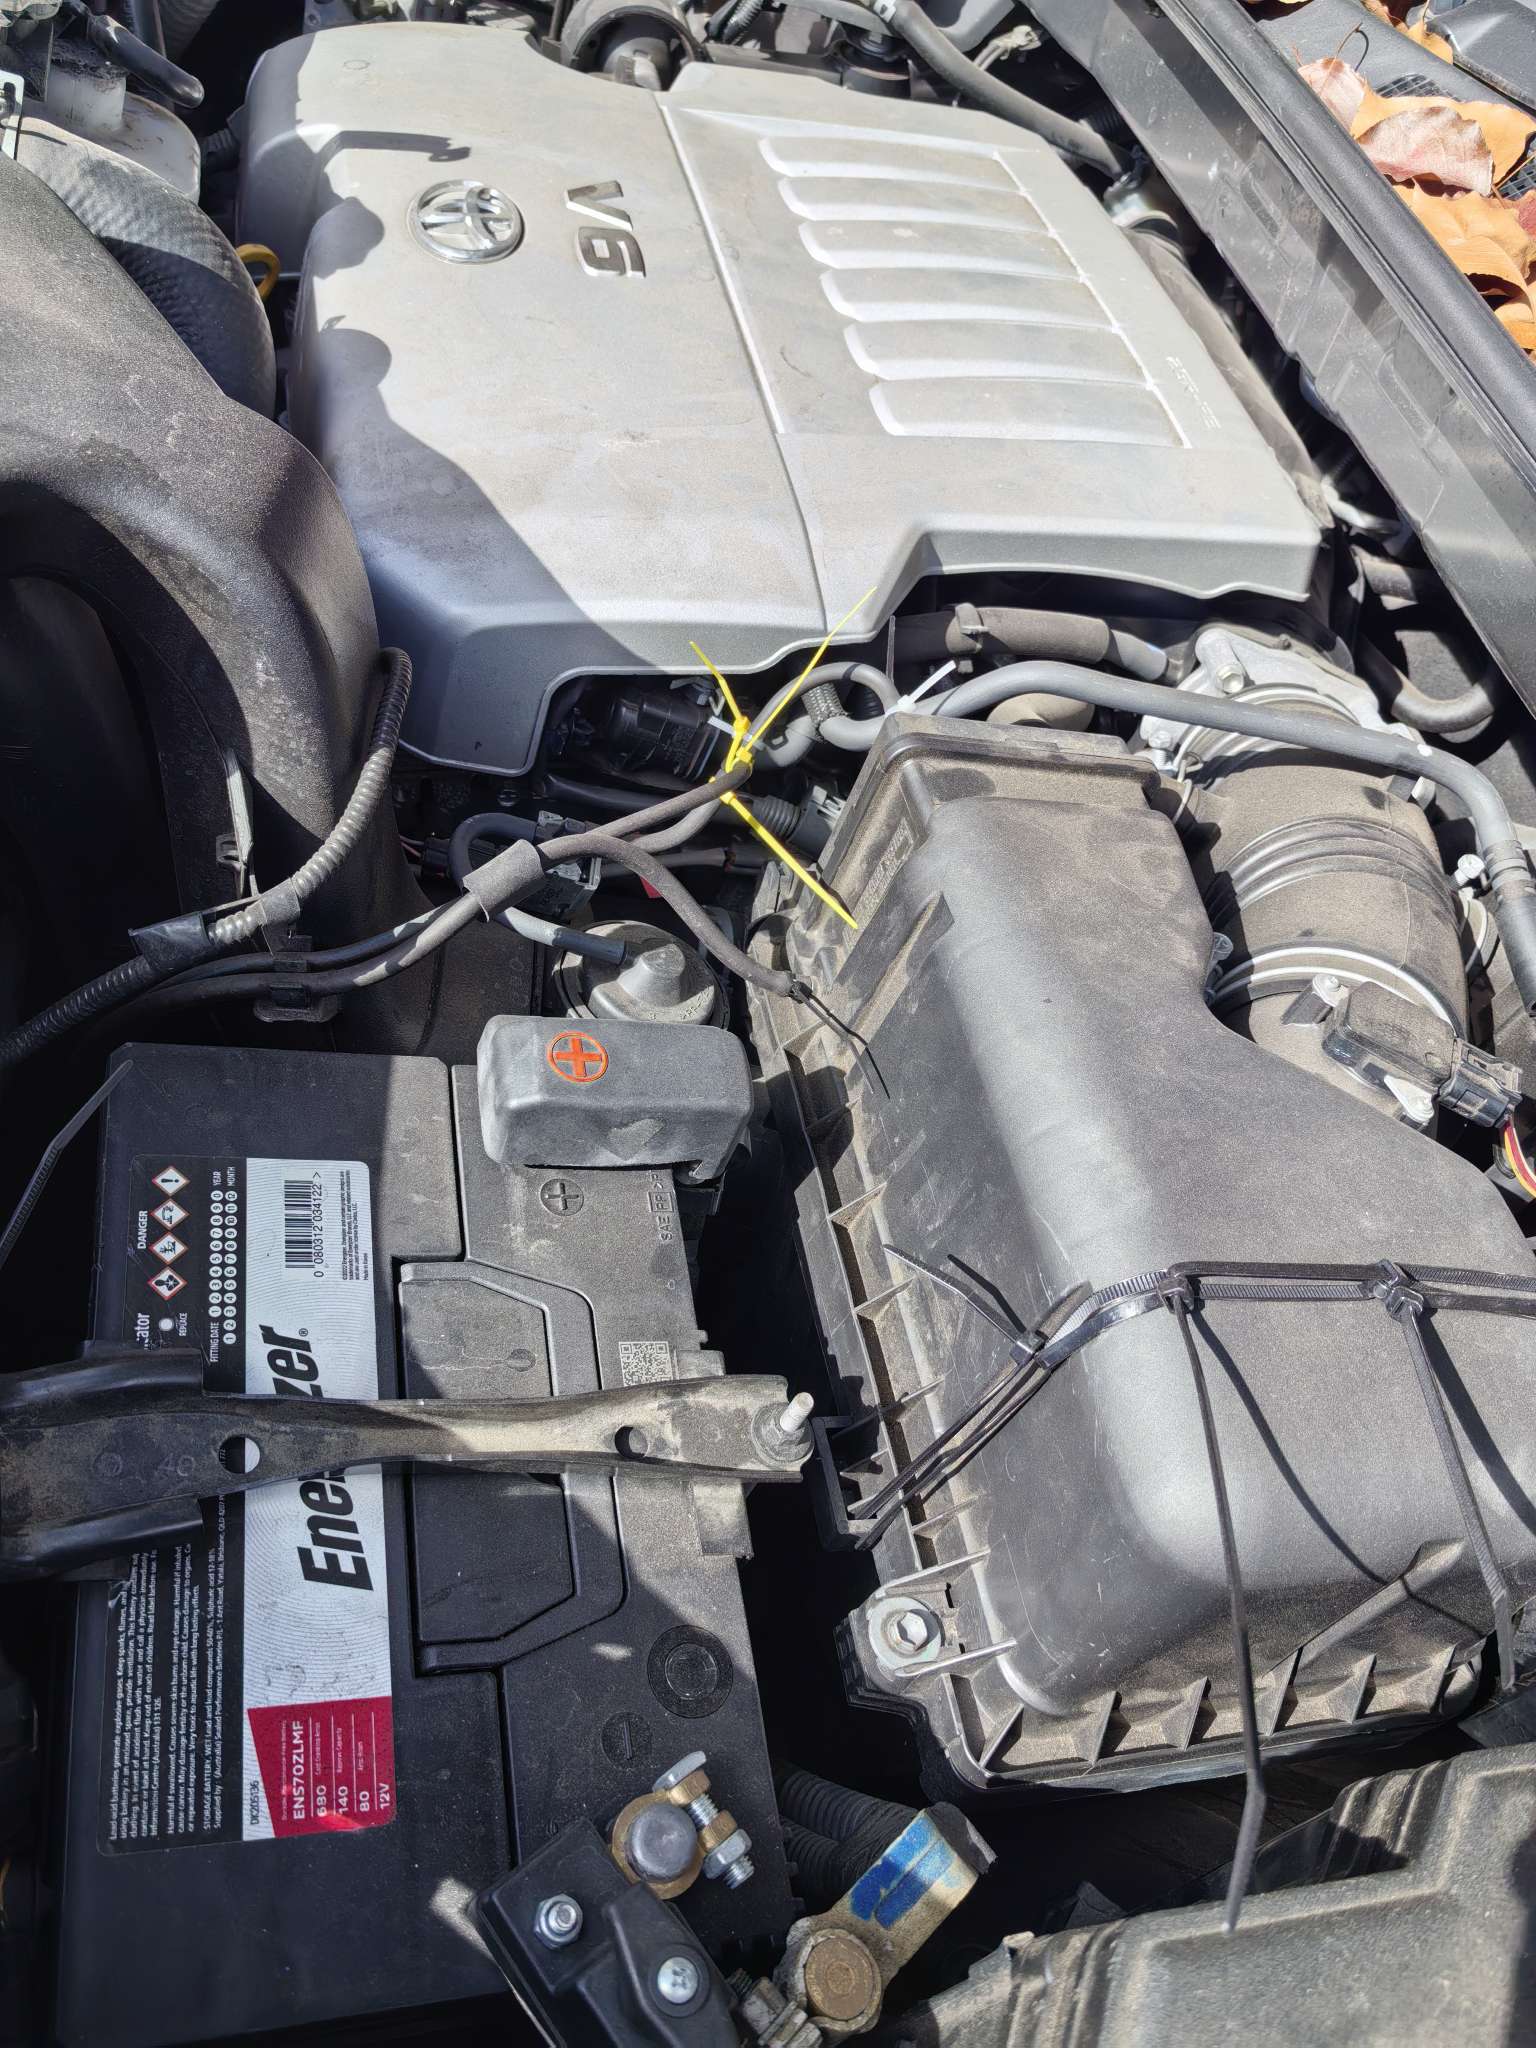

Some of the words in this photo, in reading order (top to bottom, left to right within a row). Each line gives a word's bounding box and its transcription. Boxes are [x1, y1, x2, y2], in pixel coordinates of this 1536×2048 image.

[565, 179, 645, 278] V6
[213, 1171, 222, 1186] YEAR
[227, 1166, 236, 1186] MONTH
[312, 1184, 322, 1222] 034122
[654, 1194, 668, 1210] PP
[137, 1210, 148, 1250] DANGER
[656, 1216, 672, 1241] SAE
[313, 1225, 324, 1264] 080312
[179, 1312, 188, 1337] REPLACE
[210, 1322, 219, 1338] DATE
[210, 1339, 219, 1362] FITTING
[129, 1597, 138, 1621] battery
[139, 1596, 148, 1626] physician
[184, 1587, 192, 1615] damage
[192, 1609, 200, 1631] lasting
[117, 1658, 126, 1675] Keep
[137, 1649, 145, 1662] and
[147, 1664, 154, 1672] of
[207, 1648, 215, 1688] compounds
[125, 1679, 134, 1706] provide
[183, 1699, 188, 1707] or
[191, 1678, 199, 1704] aquatic
[114, 1700, 124, 1734] explosive
[135, 1707, 143, 1725] flush
[145, 1704, 153, 1717] out
[181, 1709, 189, 1734] fertility
[191, 1705, 197, 1713] to
[144, 1719, 154, 1737] Keep
[336, 1728, 344, 1751] Capacity
[112, 1735, 123, 1768] generate
[123, 1732, 131, 1764] enclosed
[134, 1727, 142, 1757] accident
[180, 1736, 188, 1765] damage
[124, 1766, 130, 1775] an
[133, 1760, 141, 1768] of
[215, 1741, 223, 1778] (Australia)
[292, 1721, 305, 1820] ENS70ZLMF
[111, 1770, 120, 1802] batteries
[122, 1778, 129, 1786] in
[132, 1770, 140, 1792] event
[179, 1766, 187, 1783] May
[121, 1788, 130, 1816] battery
[215, 1786, 223, 1795] by
[250, 1780, 259, 1825] DK205136
[316, 1785, 327, 1817] 680
[338, 1785, 349, 1815] 140
[359, 1791, 370, 1812] 80
[379, 1783, 390, 1810] 12V
[110, 1803, 118, 1820] acid
[151, 1791, 159, 1836] Information
[188, 1788, 196, 1822] repeated
[215, 1796, 223, 1828] Supplied
[120, 1817, 129, 1838] using
[141, 1801, 149, 1837] container
